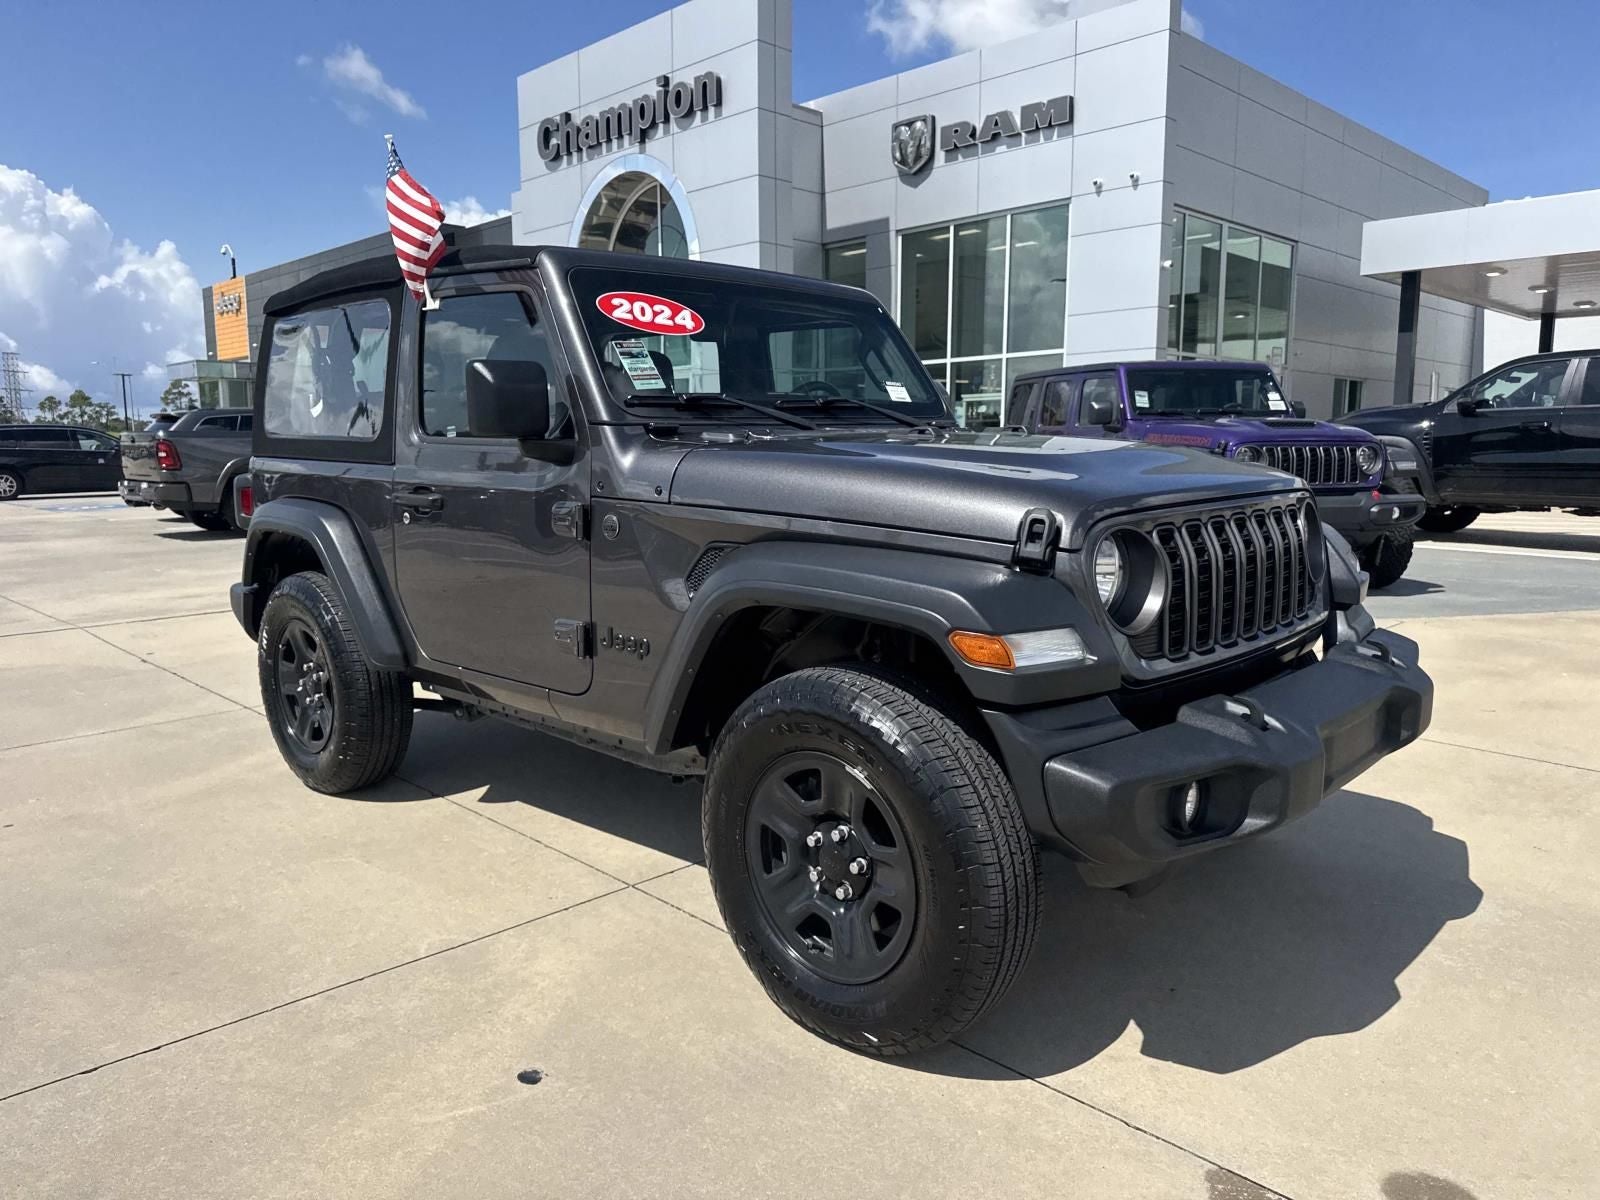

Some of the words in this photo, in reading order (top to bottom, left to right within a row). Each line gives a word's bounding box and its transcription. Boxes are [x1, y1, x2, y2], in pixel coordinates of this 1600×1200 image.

[537, 71, 721, 161] Champion
[940, 95, 1073, 151] RAM
[611, 298, 695, 330] 2024
[600, 626, 650, 660] Jeep
